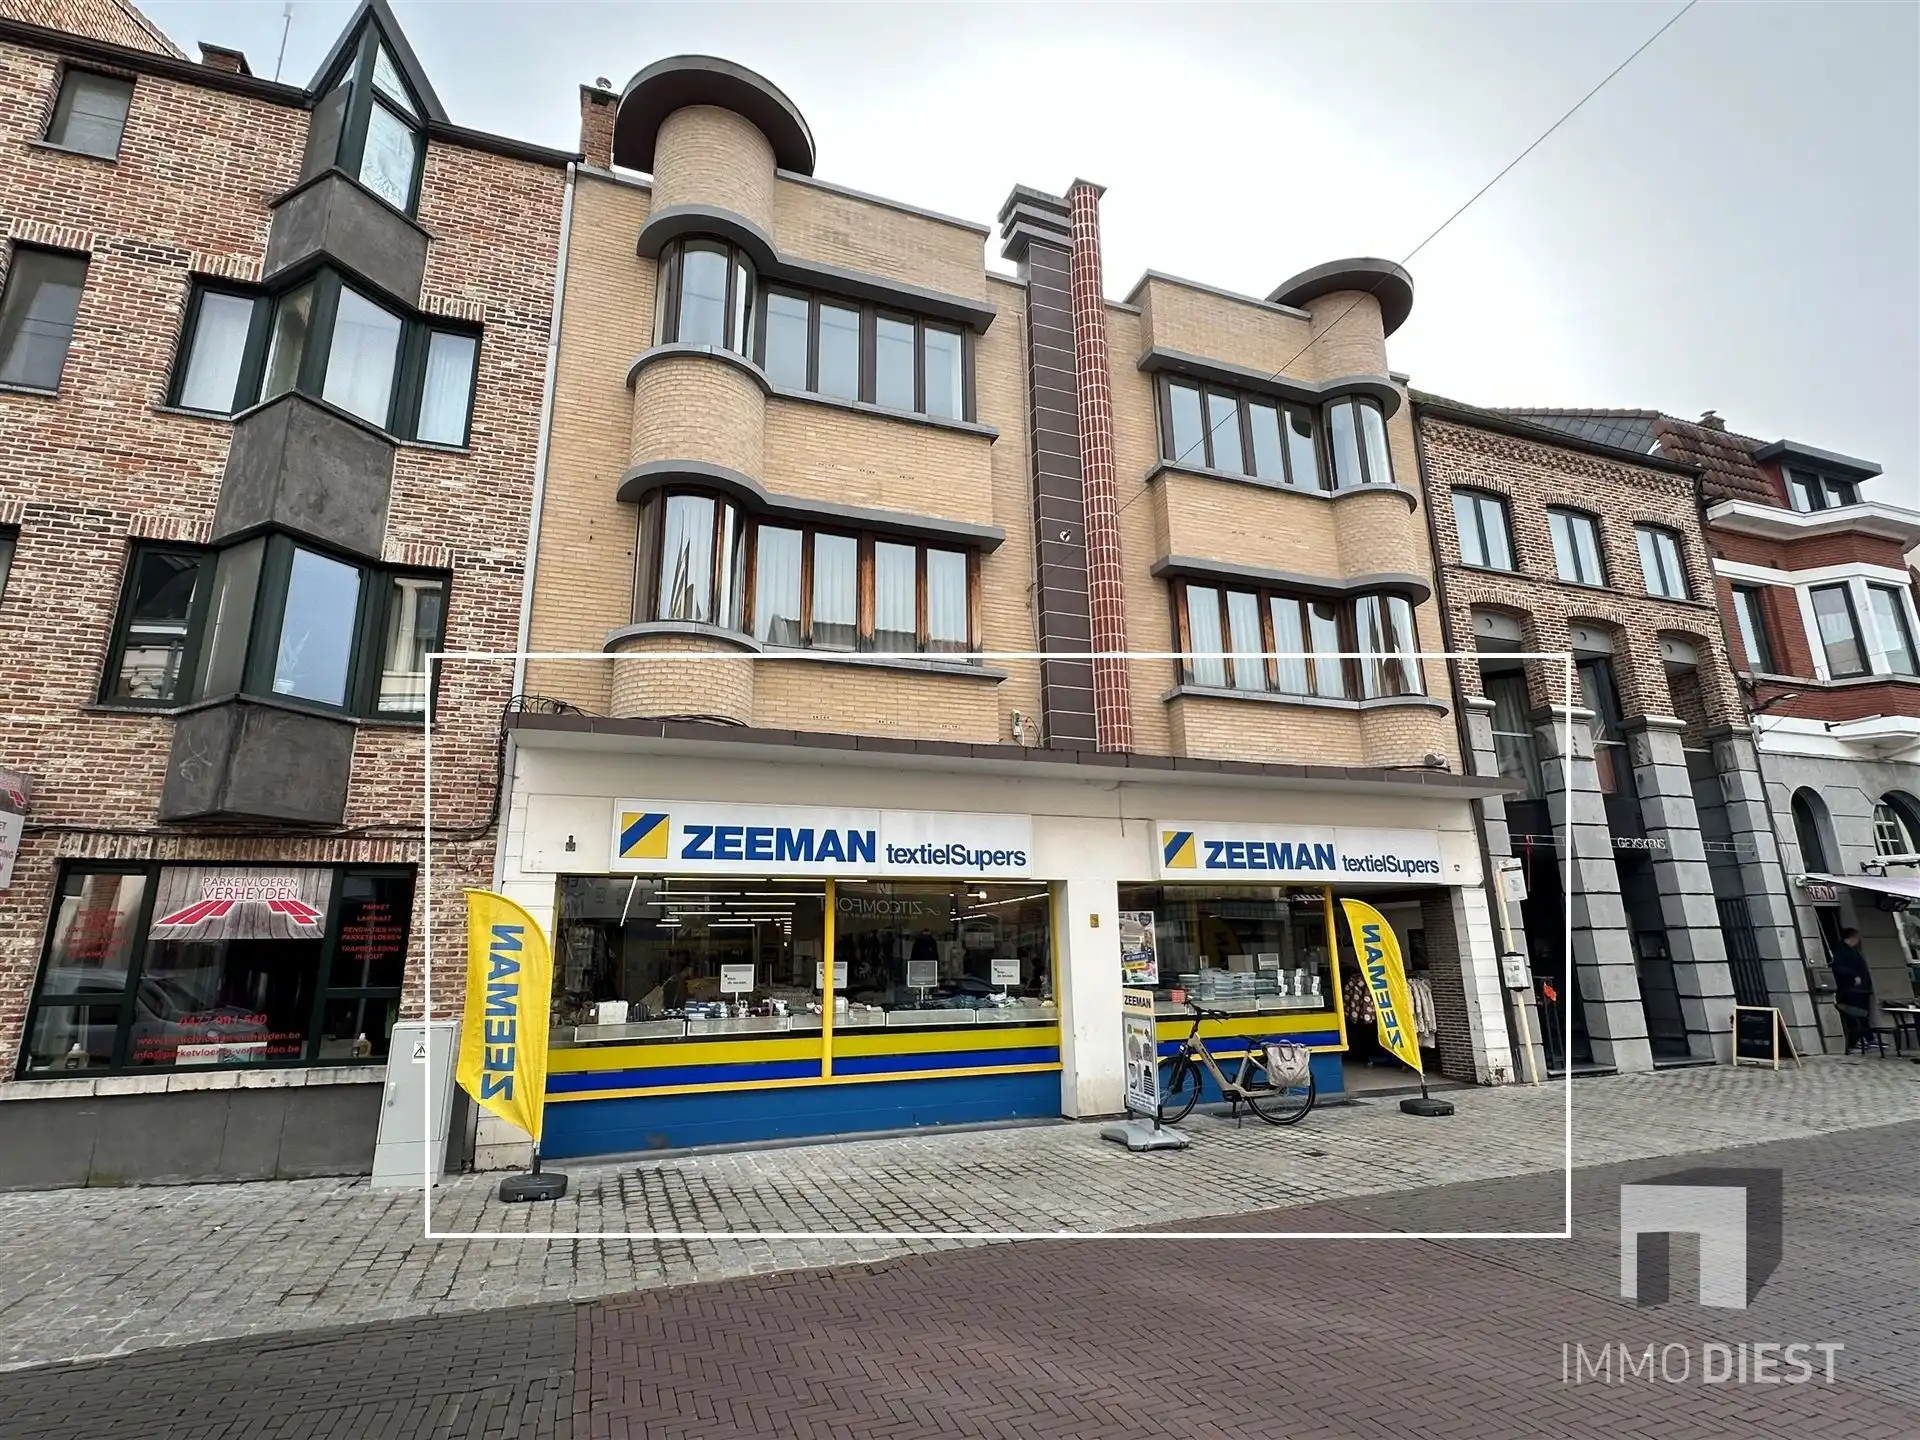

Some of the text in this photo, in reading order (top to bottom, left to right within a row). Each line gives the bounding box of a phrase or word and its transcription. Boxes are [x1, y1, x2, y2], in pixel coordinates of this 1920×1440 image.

[681, 825, 1027, 871] ZEEMAN textielSupers
[1203, 840, 1440, 877] ZEEMAN textielSupers
[203, 877, 298, 887] PARKETVLOEREN
[203, 887, 298, 900] VERHEYDEN
[1124, 995, 1151, 1009] ZEEMAN
